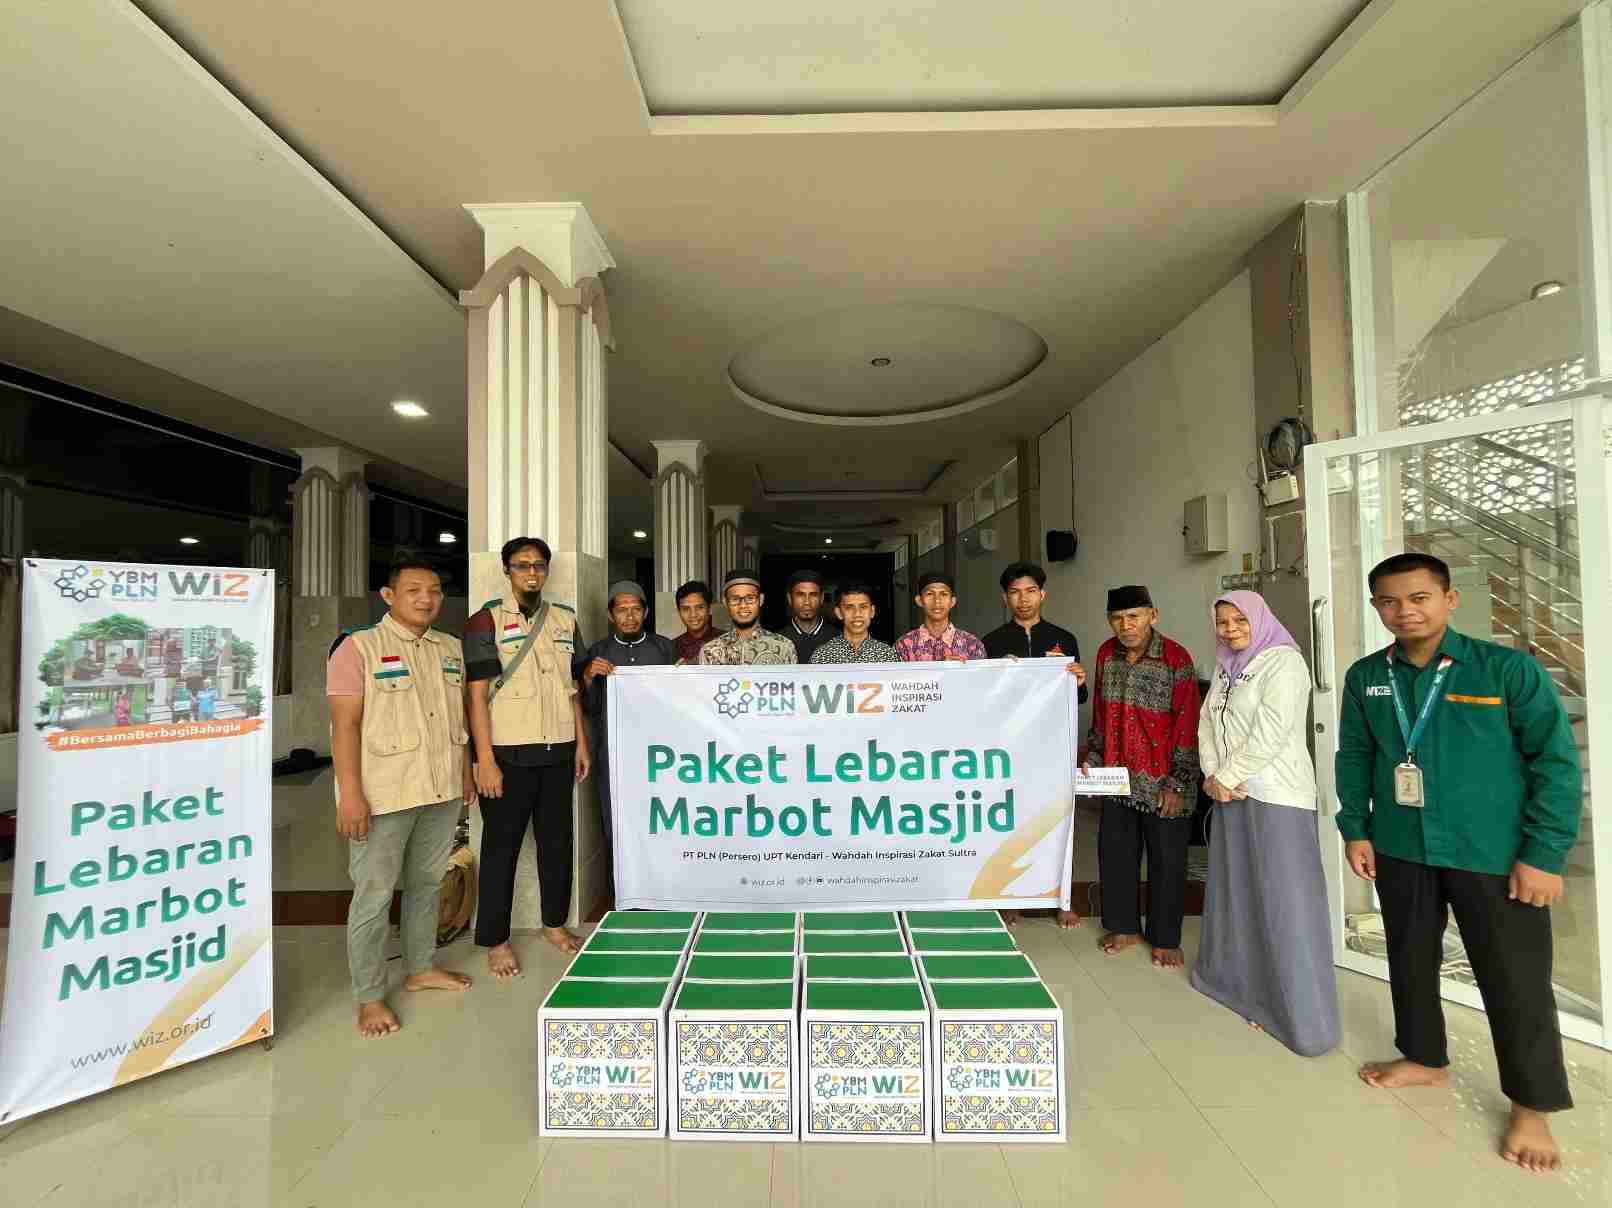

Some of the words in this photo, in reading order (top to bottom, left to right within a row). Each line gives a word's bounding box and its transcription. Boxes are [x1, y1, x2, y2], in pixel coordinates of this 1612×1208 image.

[109, 570, 159, 584] YBM
[111, 584, 159, 597] PLN
[754, 682, 795, 696] YBM
[891, 681, 939, 692] WAHDAH
[757, 697, 796, 711] PLN
[891, 693, 942, 702] INSPIRASI
[891, 703, 927, 713] ZAKAT
[647, 740, 787, 784] Paket
[806, 738, 1011, 783] Lebaran
[70, 786, 224, 836] Paket
[648, 793, 833, 838] Marbot
[849, 788, 1016, 844] Masjid
[683, 851, 694, 859] PT
[697, 851, 716, 860] PLN
[719, 851, 761, 862] (Persero)
[764, 852, 783, 861] UPT
[786, 851, 823, 860] Kendari
[832, 851, 873, 860] Wahdah
[875, 850, 916, 863] Inspirasi
[918, 849, 945, 858] Zakat
[949, 849, 977, 857] Sultra
[33, 833, 253, 896] Lebaran
[42, 876, 247, 950] Marbot
[58, 924, 227, 1001] Masjid
[70, 1011, 214, 1071] www.wiz.or.id
[575, 1065, 600, 1074] YBM
[974, 1069, 1000, 1077] YBM
[576, 1075, 600, 1085] PLN
[708, 1072, 734, 1081] YBM
[841, 1076, 867, 1085] YBM
[975, 1077, 1000, 1088] PLN
[709, 1081, 734, 1091] PLN
[842, 1085, 867, 1095] PLN
